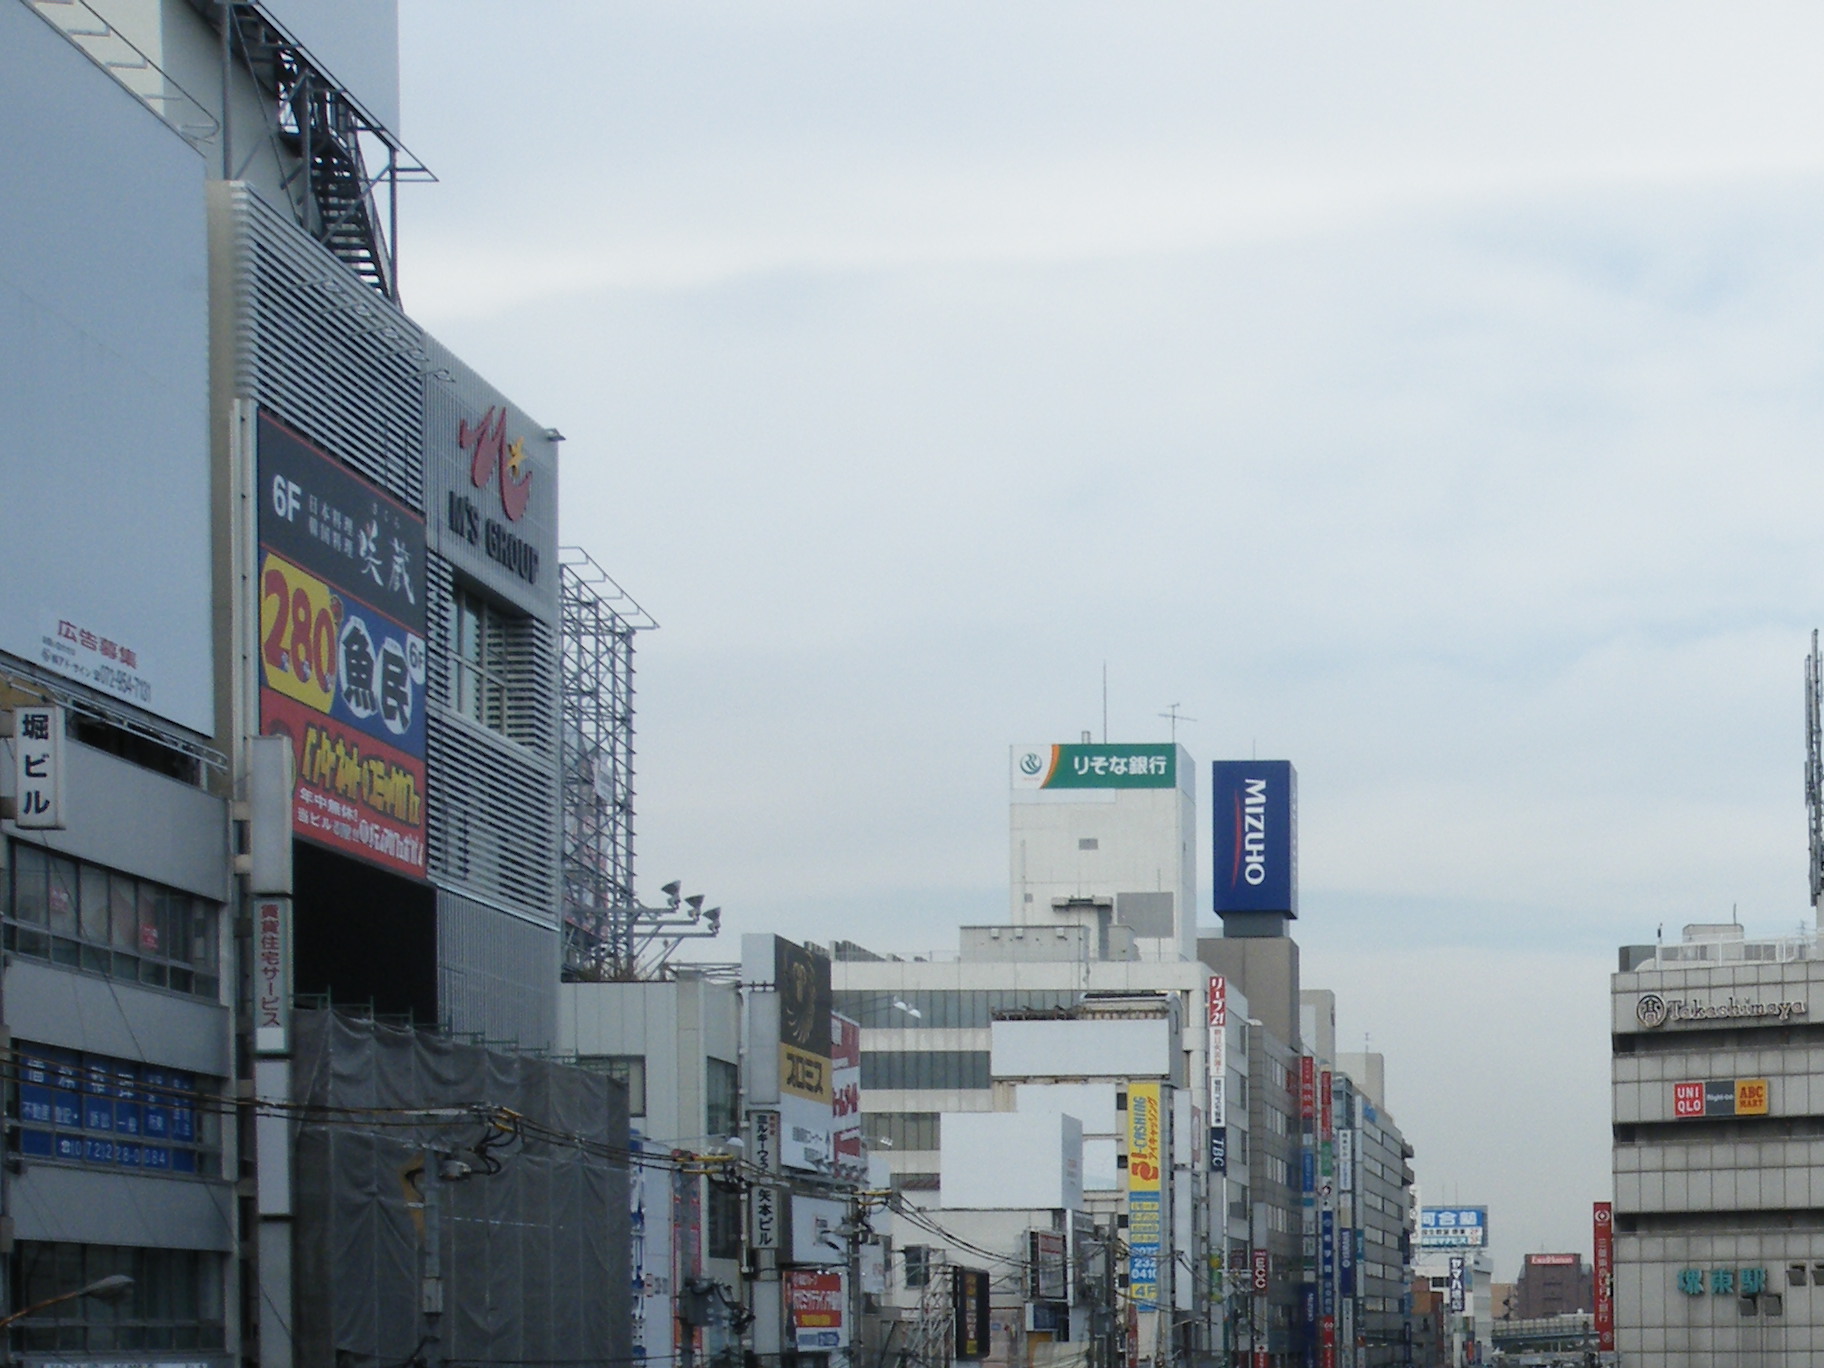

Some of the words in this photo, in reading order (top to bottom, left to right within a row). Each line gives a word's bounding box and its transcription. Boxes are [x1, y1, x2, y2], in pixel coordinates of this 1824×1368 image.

[272, 474, 302, 522] 6F
[485, 518, 539, 586] GROUP
[57, 619, 137, 670] 広告募集
[264, 568, 336, 694] 280
[342, 626, 411, 731] 魚民
[22, 713, 50, 815] 堀ビル
[1073, 755, 1168, 776] りそな銀行
[1244, 778, 1267, 887] MIZUHO
[1211, 977, 1225, 1025] リーブ21
[1666, 997, 1808, 1022] Takashimaya
[786, 1051, 824, 1095] プロミス
[1676, 1086, 1699, 1099] UNI
[1739, 1085, 1764, 1099] ABC
[1676, 1102, 1701, 1113] QLO
[1211, 1138, 1225, 1168] TBC
[758, 1188, 773, 1246] 矢本ビル
[1676, 1267, 1767, 1296] 堺東駅
